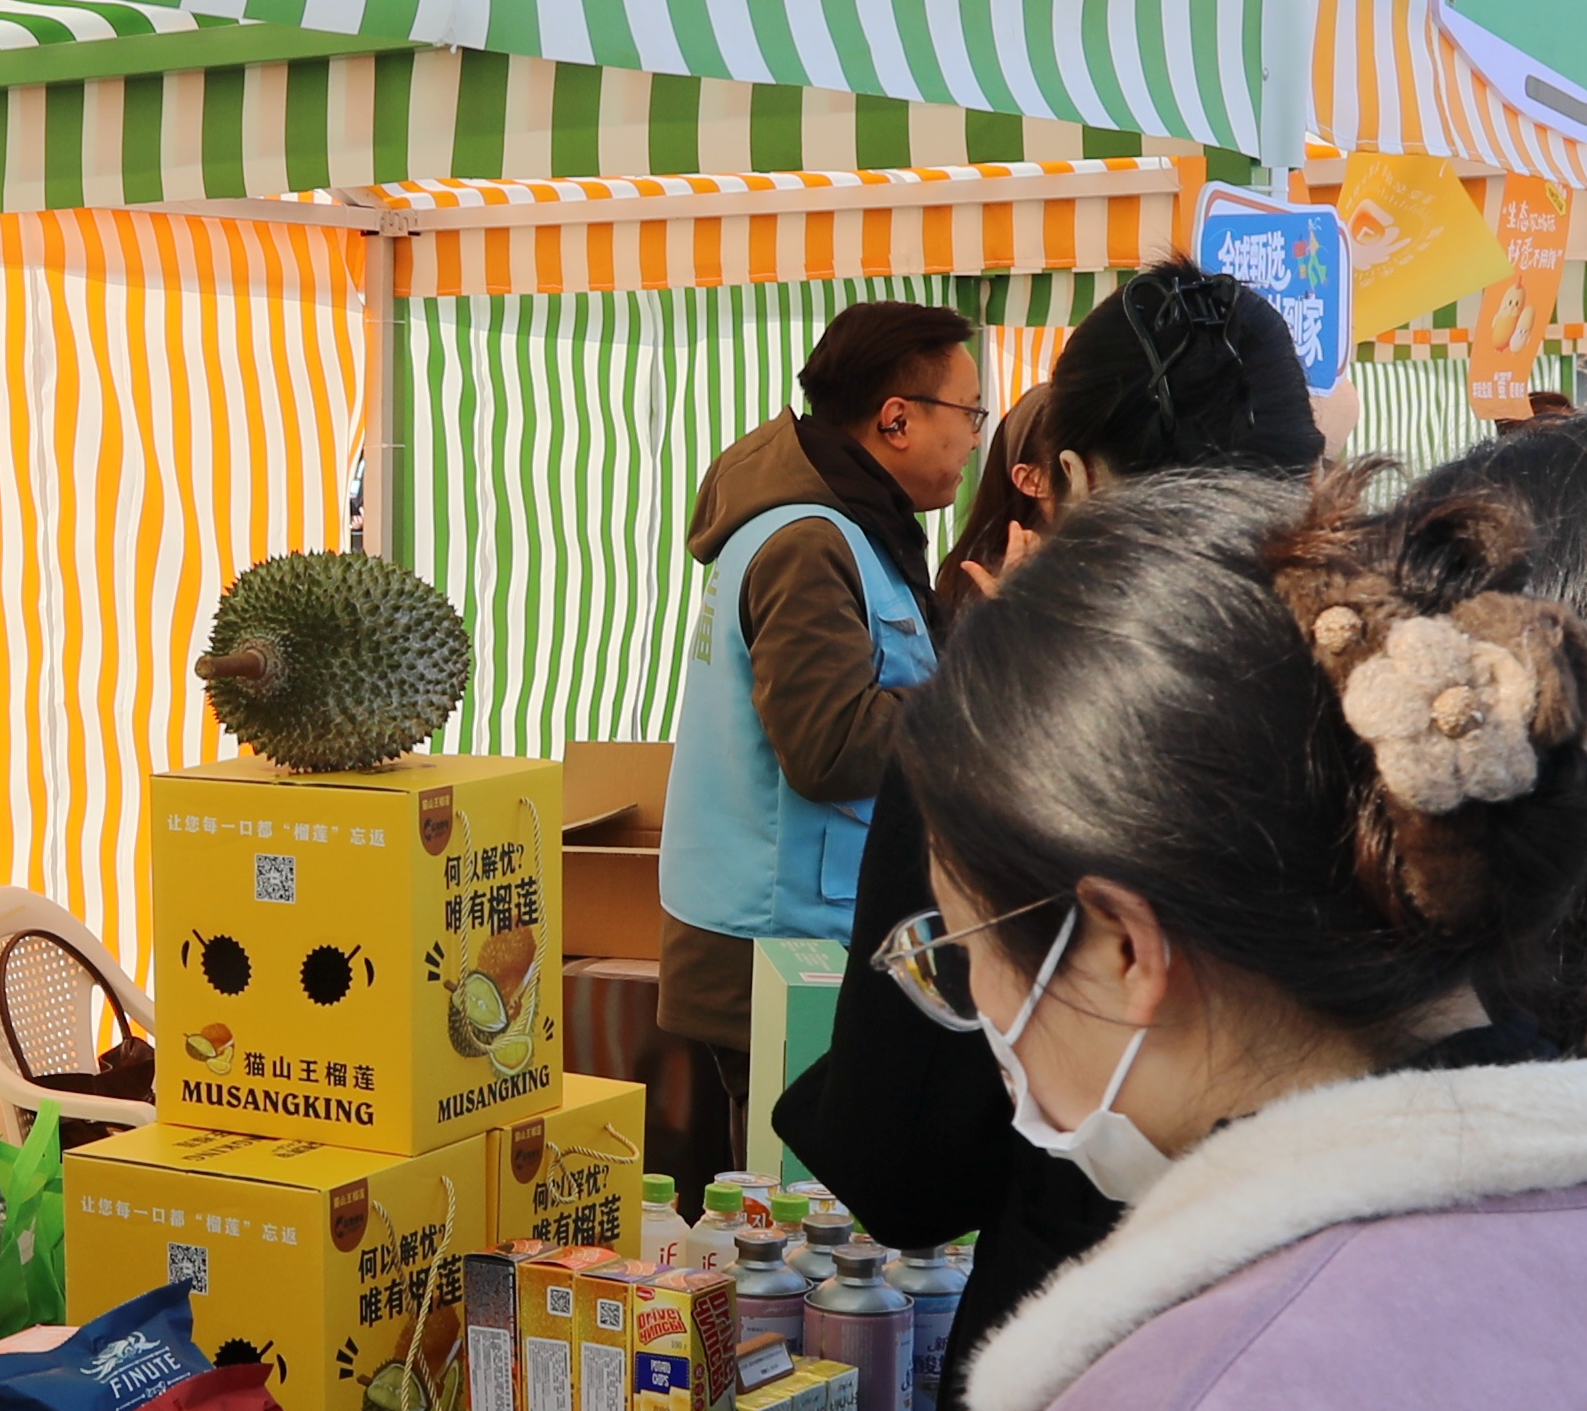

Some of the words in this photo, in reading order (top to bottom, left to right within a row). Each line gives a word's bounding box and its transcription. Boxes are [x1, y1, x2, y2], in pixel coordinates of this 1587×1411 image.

[1217, 229, 1293, 292] 全球甄选
[444, 874, 540, 937] 唯有榴莲
[242, 1050, 377, 1093] 猫山王榴莲
[436, 1063, 551, 1126] MUSANGKING
[180, 1078, 376, 1127] MUSANGKING
[108, 1349, 183, 1400] FINUTE
